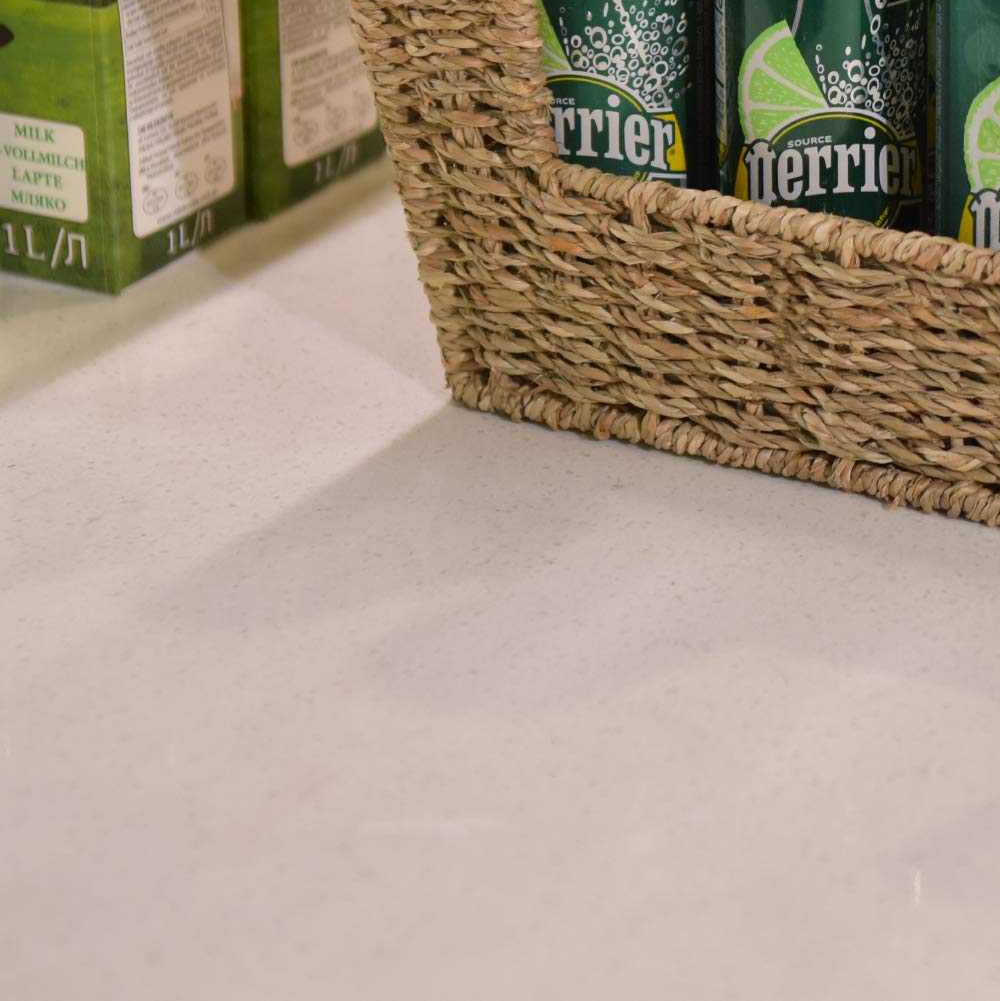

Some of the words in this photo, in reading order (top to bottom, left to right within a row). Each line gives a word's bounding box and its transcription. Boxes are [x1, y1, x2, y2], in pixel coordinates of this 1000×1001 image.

[551, 97, 575, 106] RCE
[14, 122, 55, 144] MILK
[552, 95, 674, 171] rrier
[787, 134, 832, 148] SOURCE
